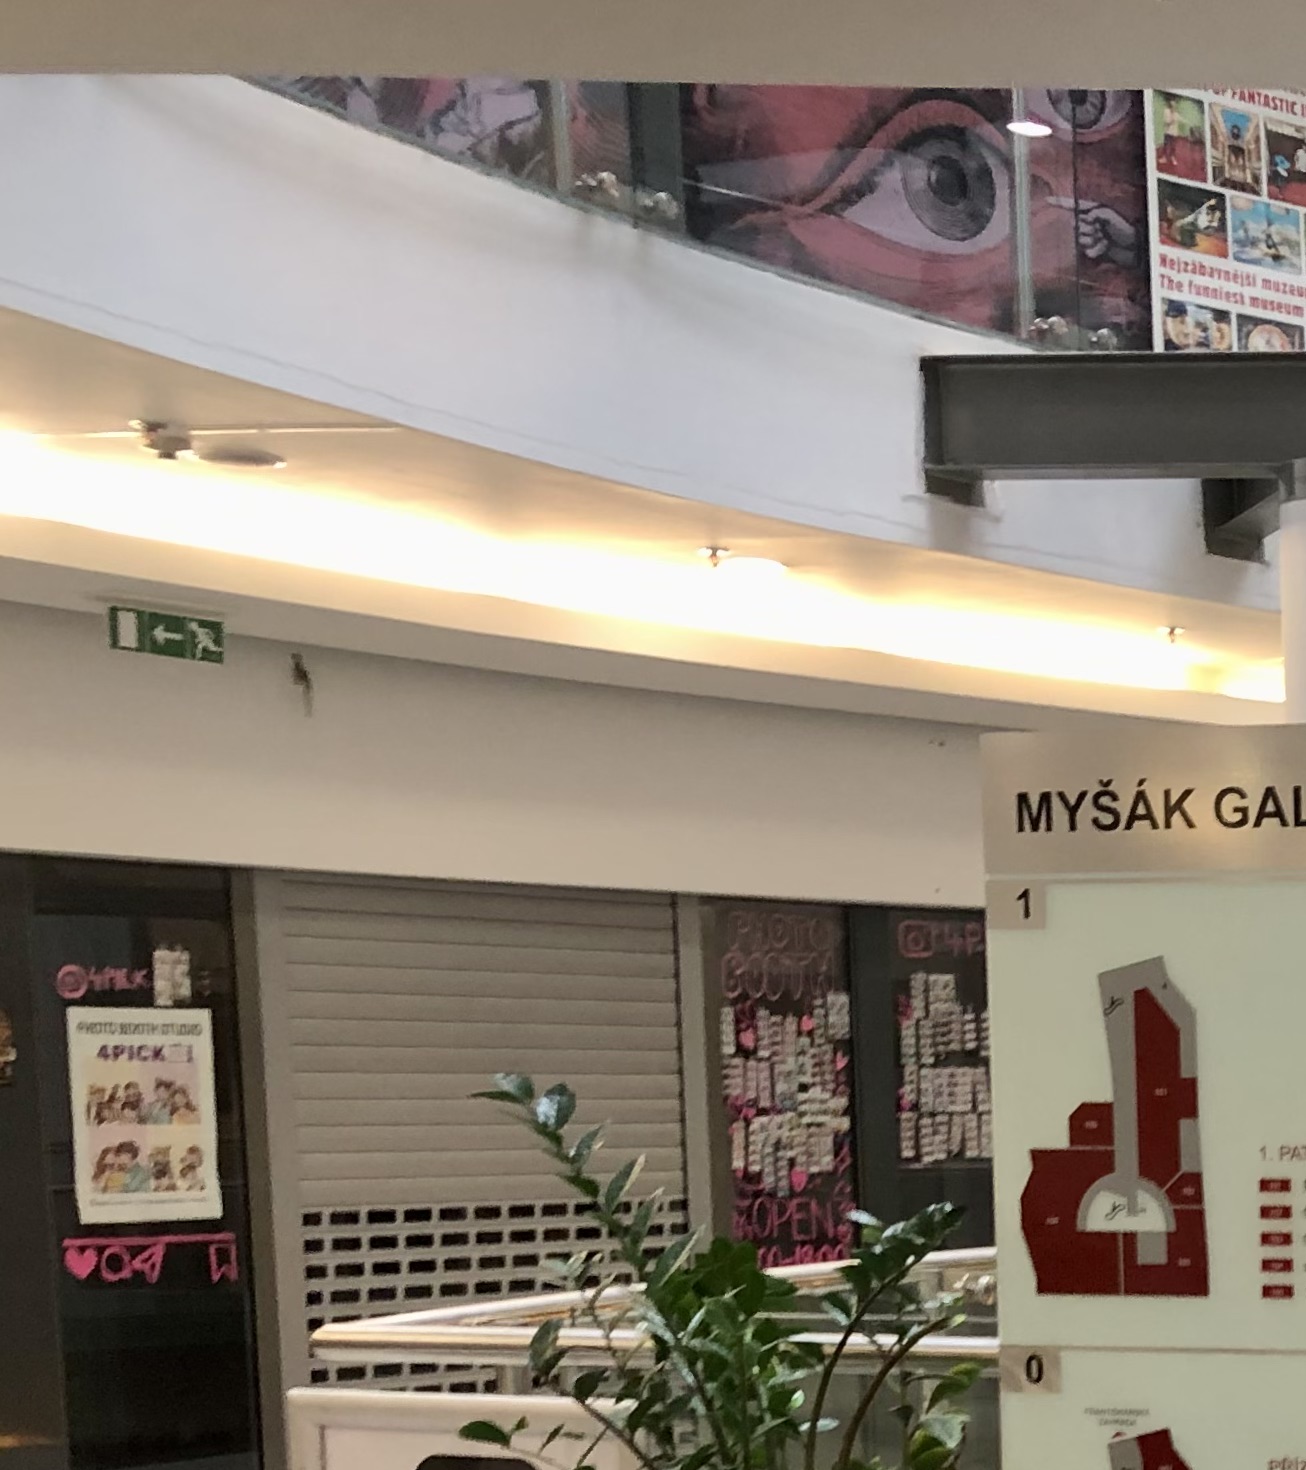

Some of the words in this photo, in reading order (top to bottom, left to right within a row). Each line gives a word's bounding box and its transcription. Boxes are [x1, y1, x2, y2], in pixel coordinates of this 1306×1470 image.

[1231, 88, 1297, 115] FANTASTIC
[1160, 274, 1184, 293] The
[1188, 280, 1245, 306] funniest
[1249, 295, 1304, 317] museum
[1016, 778, 1198, 833] MYŠÁK
[1016, 888, 1031, 919] 1
[753, 1197, 835, 1242] OPEN
[1025, 1354, 1044, 1384] 0
